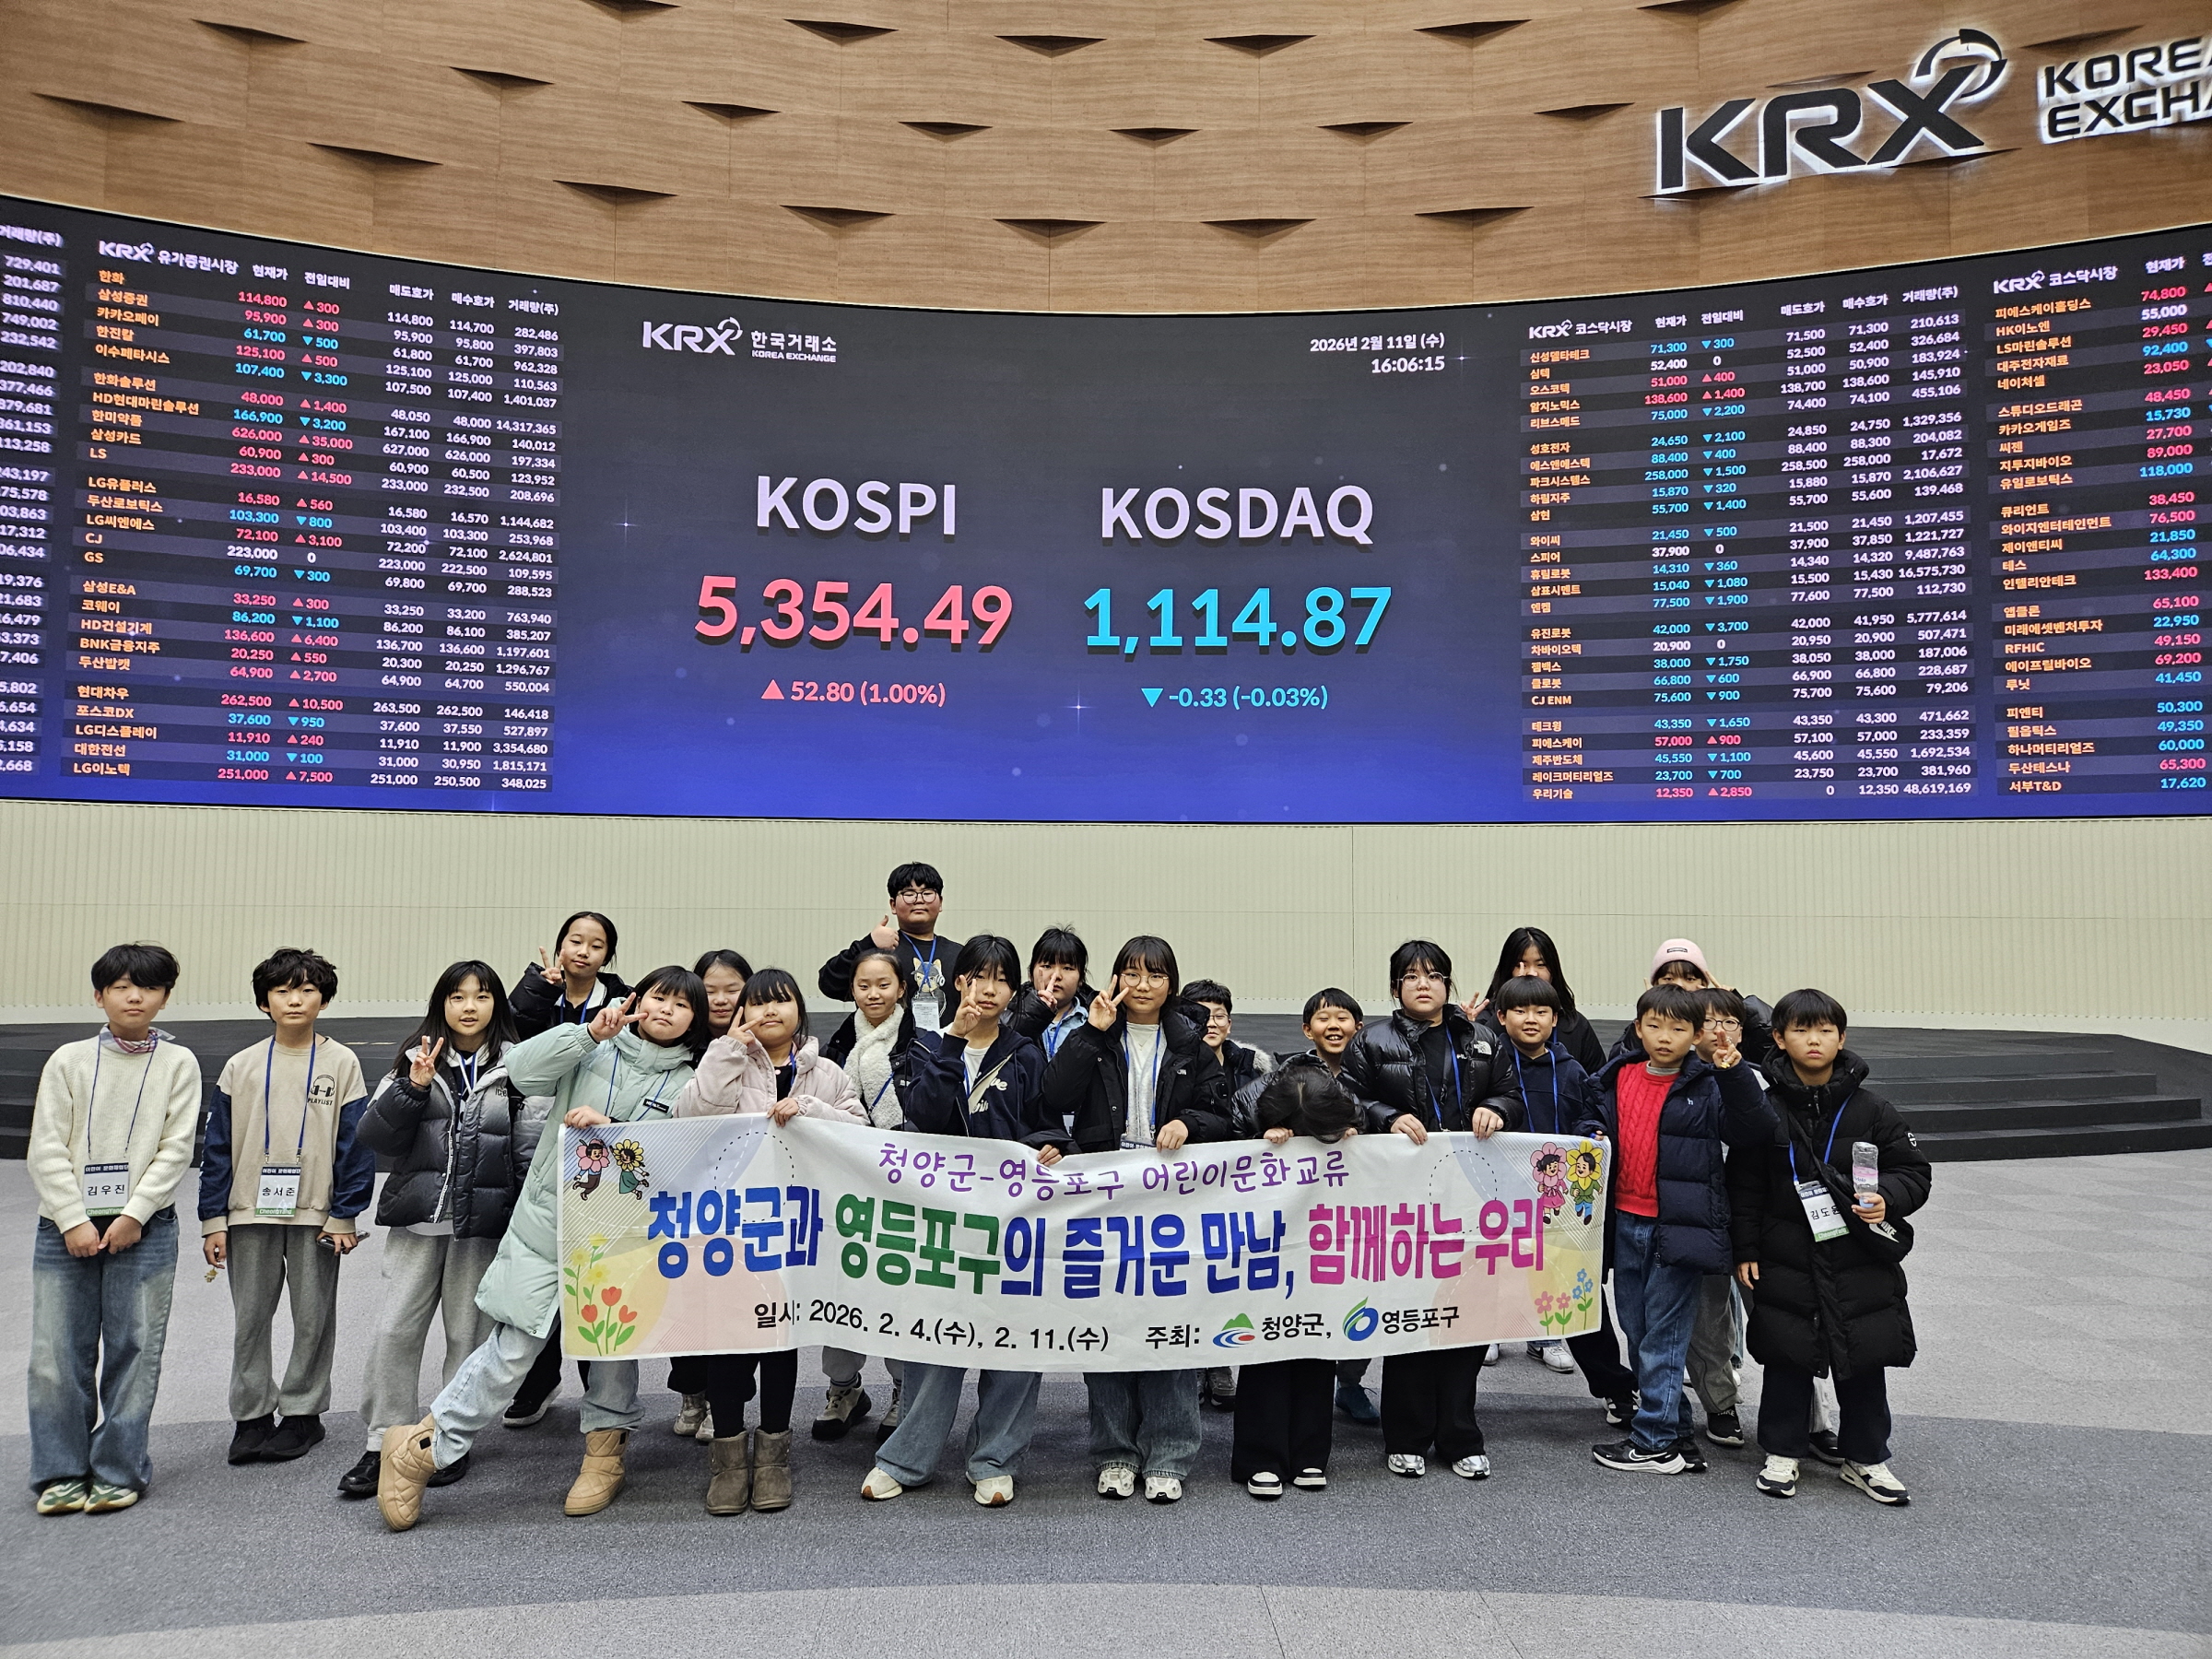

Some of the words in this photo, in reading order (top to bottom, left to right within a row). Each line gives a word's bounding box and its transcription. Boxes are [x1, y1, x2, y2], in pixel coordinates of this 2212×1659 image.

[2045, 37, 2212, 98] KORE
[1661, 29, 2007, 190] KRX
[2048, 80, 2212, 138] EXCH
[3, 274, 61, 293] 201,687
[99, 240, 155, 263] KRX
[158, 249, 239, 276] 유가증권시장
[253, 265, 288, 280] 현재가
[390, 284, 434, 300] 매도호가
[452, 292, 495, 308] 매수호가
[1994, 269, 2045, 294] KRX
[2049, 265, 2119, 288] 코스닥시장
[2145, 256, 2186, 274] 현재가
[98, 288, 147, 306] 삼성증권
[245, 310, 287, 324] 95,900
[316, 320, 338, 332] 300
[394, 330, 432, 344] 95,900
[456, 337, 493, 351] 95,800
[514, 344, 558, 358] 397,803
[1529, 319, 1572, 339] KRX
[1575, 319, 1632, 335] 코스닥시장
[1655, 315, 1687, 328] 현재가
[1701, 310, 1743, 324] 전일대비
[1781, 300, 1825, 316] 매도호가
[1842, 293, 1888, 309] 매수호가
[641, 317, 743, 356] KRX
[751, 330, 837, 352] 한국거래소
[1310, 336, 1358, 352] 2026년
[1360, 335, 1383, 351] 2월
[1386, 334, 1417, 349] 11일
[1420, 332, 1445, 349] (수)
[1651, 359, 1688, 371] 52,400
[1713, 356, 1721, 365] 0
[1787, 346, 1825, 359] 52,500
[1849, 339, 1888, 352] 52,400
[1912, 332, 1959, 346] 326,684
[751, 349, 784, 359] KOREA
[785, 352, 837, 363] EXCHANGE
[1371, 356, 1445, 373] 16:06:15
[1997, 355, 2069, 372] 대주전자재료
[2143, 341, 2188, 356] 92,400
[95, 344, 170, 363] 이수페타시스
[236, 363, 284, 378] 107,400
[314, 372, 347, 385] 3,300
[386, 382, 431, 395] 107,500
[448, 389, 492, 402] 107,400
[504, 394, 557, 407] 1,401,037
[1531, 442, 1571, 454] 성호전자
[1652, 435, 1688, 446] 24,650
[1715, 431, 1745, 442] 2,100
[1788, 424, 1827, 436] 24,850
[1851, 418, 1890, 431] 24,750
[1903, 412, 1961, 427] 1,329,356
[1999, 419, 2071, 435] 카카오게임즈
[2146, 407, 2191, 421] 15,730
[90, 448, 107, 459] LS
[230, 463, 280, 477] 233,000
[312, 472, 351, 485] 14,500
[382, 478, 428, 492] 233,000
[444, 484, 489, 497] 232,500
[510, 489, 554, 502] 208,696
[2000, 455, 2072, 471] 지투지바이오
[2147, 444, 2193, 458] 89,000
[757, 475, 956, 535] KOSPI
[1101, 485, 1373, 545] KOSDAQ
[86, 533, 102, 544] CJ
[227, 546, 277, 559] 223,000
[307, 552, 316, 563] 0
[379, 559, 425, 571] 223,000
[441, 563, 487, 575] 222,500
[509, 569, 552, 580] 109,595
[1531, 552, 1559, 562] 스피어
[1653, 547, 1689, 557] 37,900
[1715, 545, 1724, 553] 0
[1790, 538, 1829, 549] 37,900
[1853, 534, 1892, 546] 37,850
[1905, 528, 1964, 542] 1,221,727
[2002, 538, 2062, 553] 제이앤티씨
[2150, 529, 2195, 542] 21,850
[82, 600, 119, 613] 코웨이
[232, 611, 275, 624] 86,200
[306, 617, 339, 628] 1,100
[383, 622, 423, 633] 86,200
[447, 626, 485, 637] 86,100
[507, 629, 550, 641] 385,207
[694, 575, 1013, 645] 5,354.49
[1084, 586, 1392, 653] 1,114.87
[1532, 644, 1581, 655] 차바이오텍
[1653, 641, 1690, 652] 20,900
[1717, 640, 1725, 649] 0
[1792, 635, 1830, 646] 20,950
[1854, 631, 1895, 643] 20,900
[1918, 628, 1967, 640] 507,471
[2006, 642, 2044, 653] RFHIC
[2155, 633, 2200, 646] 49,150
[790, 680, 855, 702] 52.80
[860, 680, 946, 707] (1.00%)
[1169, 688, 1228, 707] -0.33
[1232, 685, 1329, 709] (-0.03%)
[1533, 755, 1582, 765] 제주반도체
[1655, 753, 1692, 763] 45,550
[1721, 752, 1750, 762] 1,100
[1794, 750, 1833, 760] 45,600
[1857, 748, 1898, 759] 45,550
[1911, 747, 1971, 758] 1,692,534
[2008, 742, 2094, 755] 하나머티리얼즈
[2159, 739, 2204, 750] 60,000
[75, 763, 129, 775] LG이노텍
[218, 769, 268, 780] 251,000
[300, 772, 332, 782] 7,500
[371, 774, 418, 784] 251,000
[434, 776, 480, 786] 250,500
[502, 778, 546, 788] 348,025
[307, 1098, 333, 1106] PLAYLIST
[88, 1184, 125, 1196] 김우진
[262, 1187, 296, 1196] 송서준
[648, 1185, 823, 1279] 청양군과
[835, 1193, 1046, 1299] 영등포구의
[1063, 1213, 1190, 1300] 즐거운
[1201, 1209, 1294, 1300] 만남,
[1309, 1202, 1463, 1286] 함께하는
[1477, 1198, 1545, 1272] 우리
[754, 1300, 801, 1330] 일시:
[808, 1300, 868, 1331] 2026.
[879, 1312, 900, 1337] 2.
[910, 1318, 982, 1349] 4.(수),
[995, 1326, 1017, 1348] 2.
[1030, 1325, 1109, 1352] 11.(수)
[1145, 1324, 1200, 1349] 주최:
[1261, 1312, 1332, 1342] 청양군,
[1382, 1306, 1460, 1335] 영등포구
